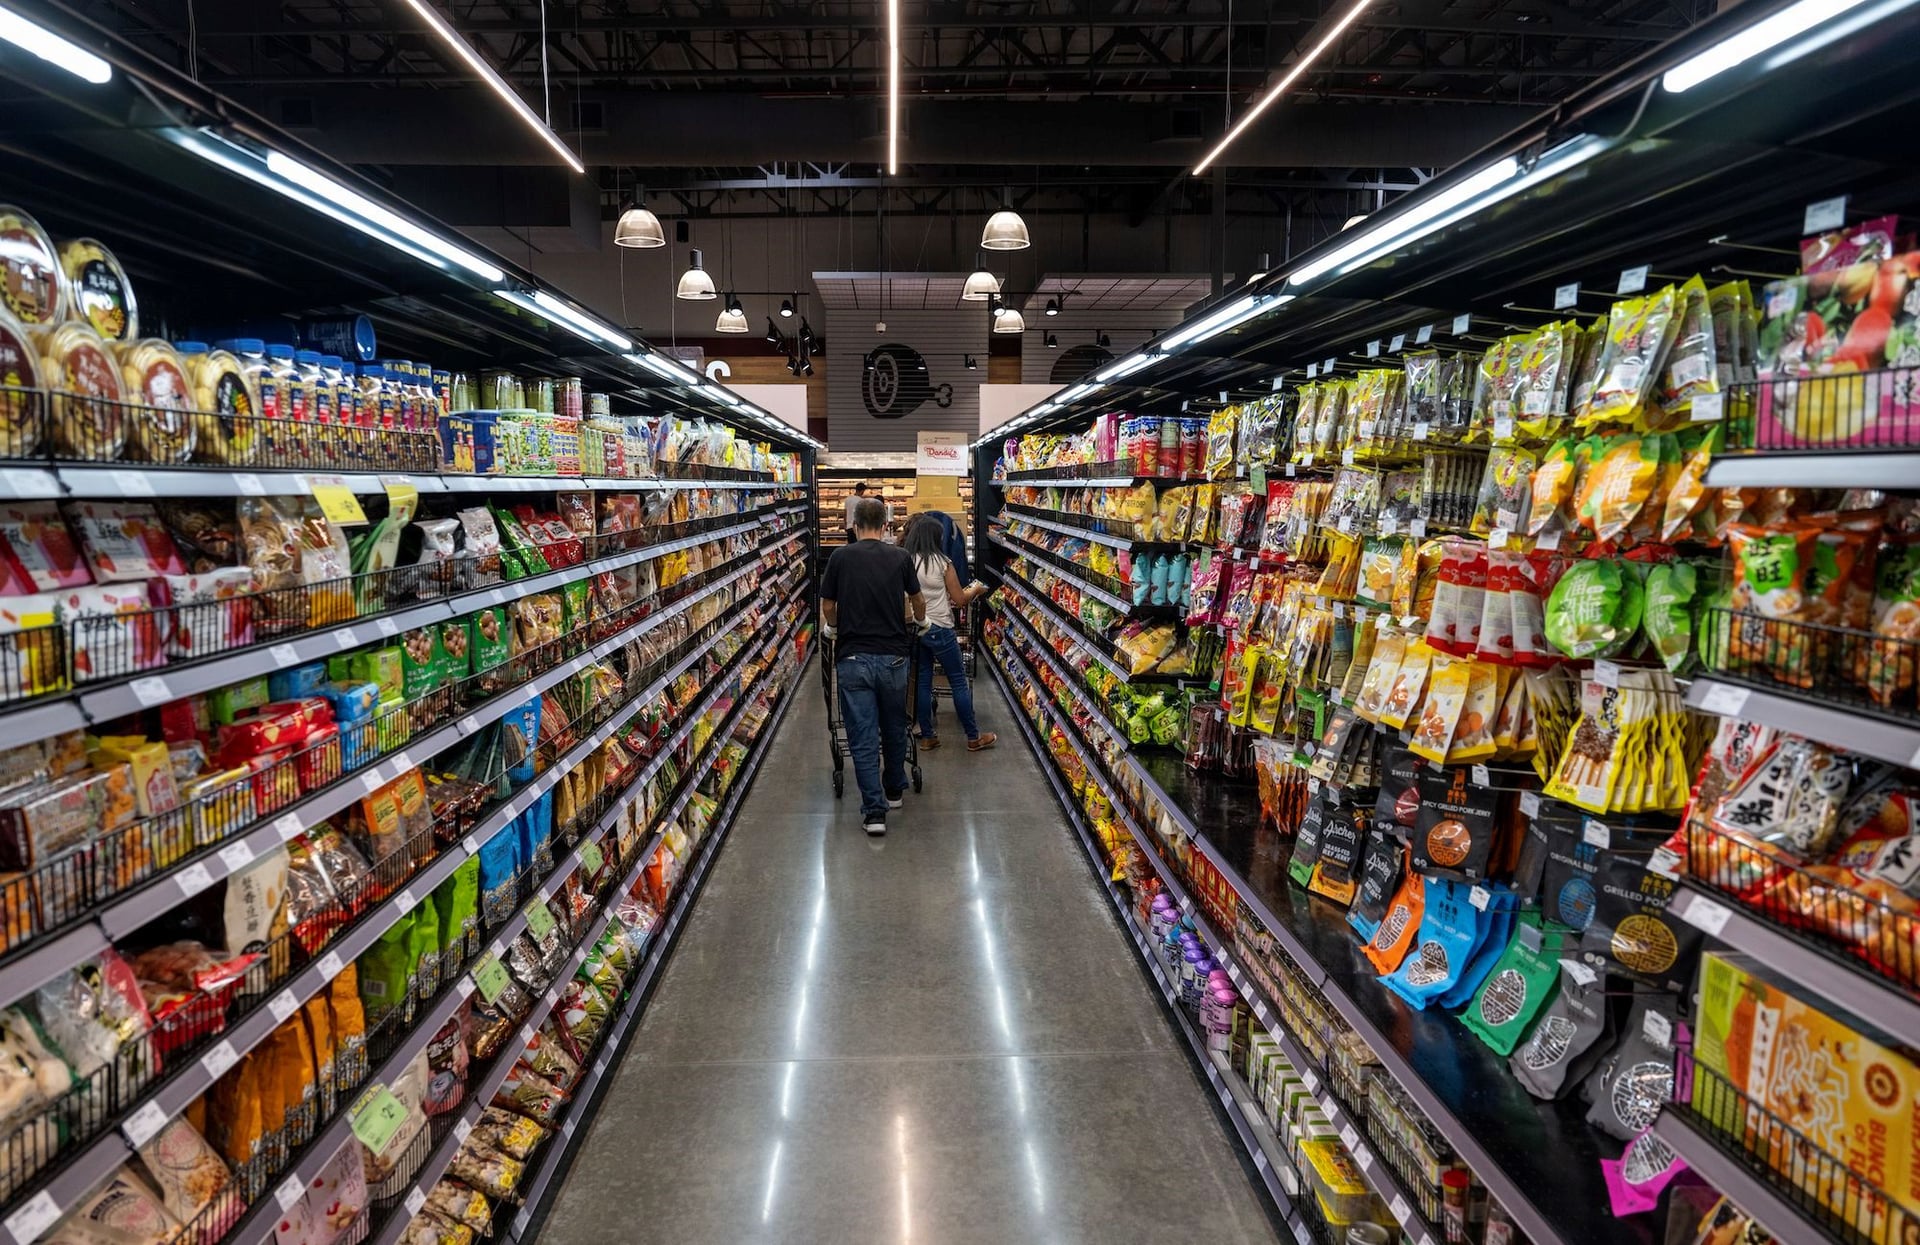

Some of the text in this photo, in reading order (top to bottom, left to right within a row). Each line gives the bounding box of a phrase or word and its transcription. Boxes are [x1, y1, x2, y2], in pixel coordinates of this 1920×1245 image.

[1422, 800, 1437, 809] SPICY
[1437, 802, 1458, 812] GRILLED
[1459, 806, 1474, 815] PORK
[1473, 808, 1492, 818] JERKY
[1323, 820, 1356, 845] Archer
[1550, 851, 1598, 874] ORIGINAL BEEF
[1603, 884, 1643, 902] GRILLED
